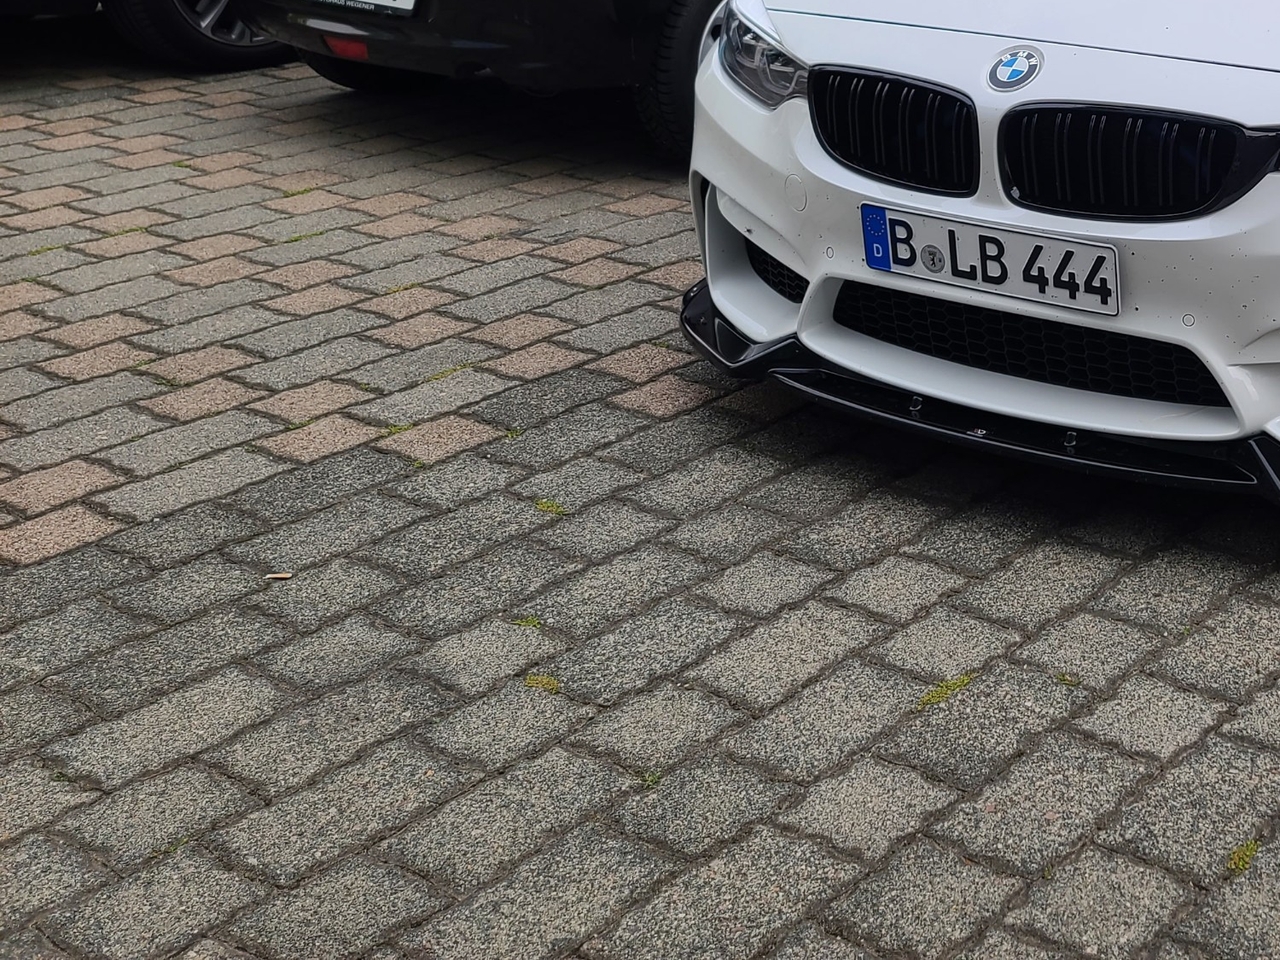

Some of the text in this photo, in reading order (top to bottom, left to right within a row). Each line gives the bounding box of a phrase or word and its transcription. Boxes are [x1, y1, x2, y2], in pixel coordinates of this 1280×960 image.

[346, 0, 375, 10] WEGENER
[1002, 50, 1038, 65] BMW
[873, 243, 883, 257] D
[888, 217, 1112, 305] B LB 444
